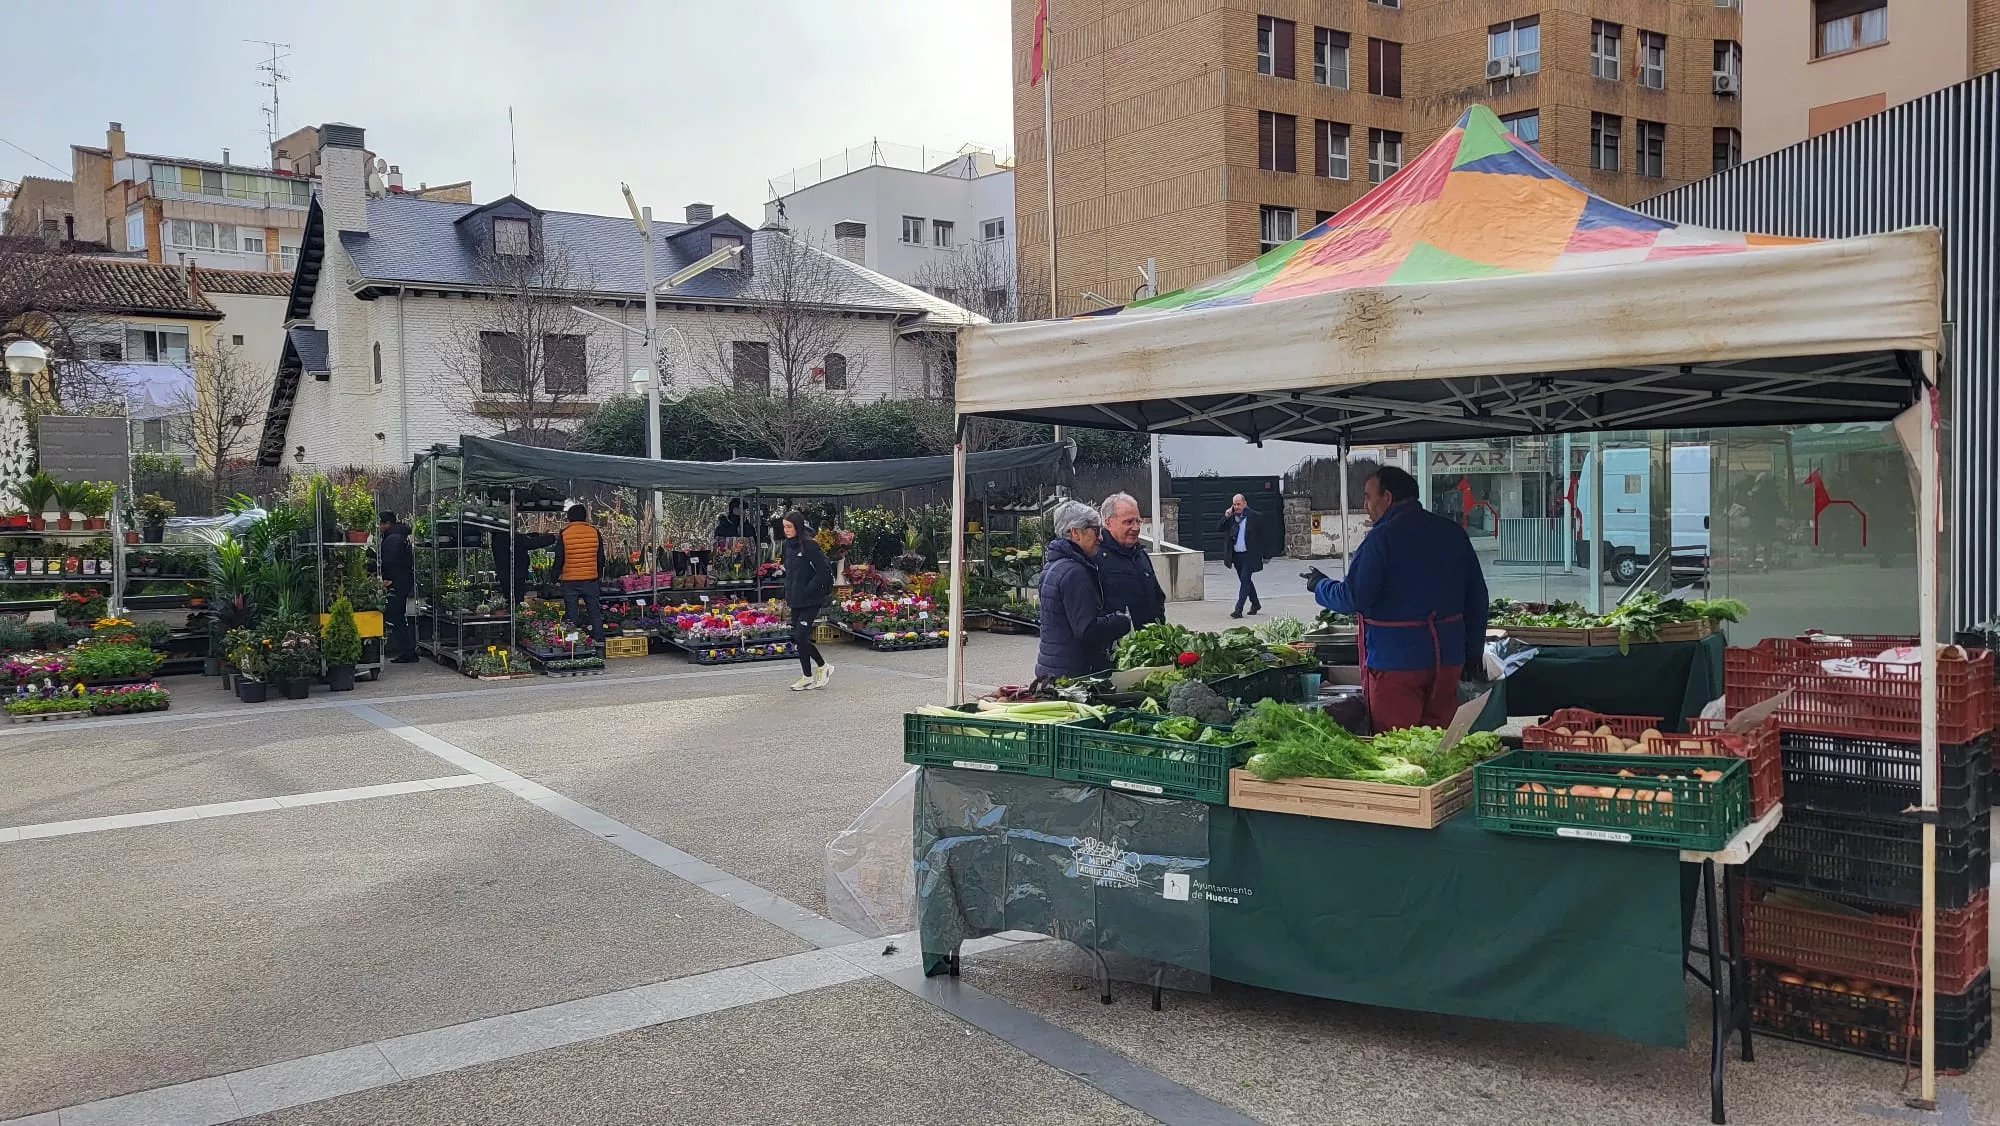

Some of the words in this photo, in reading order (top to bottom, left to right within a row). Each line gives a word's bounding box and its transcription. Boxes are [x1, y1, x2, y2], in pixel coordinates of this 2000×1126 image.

[1432, 452, 1504, 466] AZAR
[1089, 857, 1125, 871] MERCADO
[1192, 879, 1253, 896] Ayuntamiento
[1191, 890, 1203, 900] de
[1205, 891, 1239, 904] Huesca
